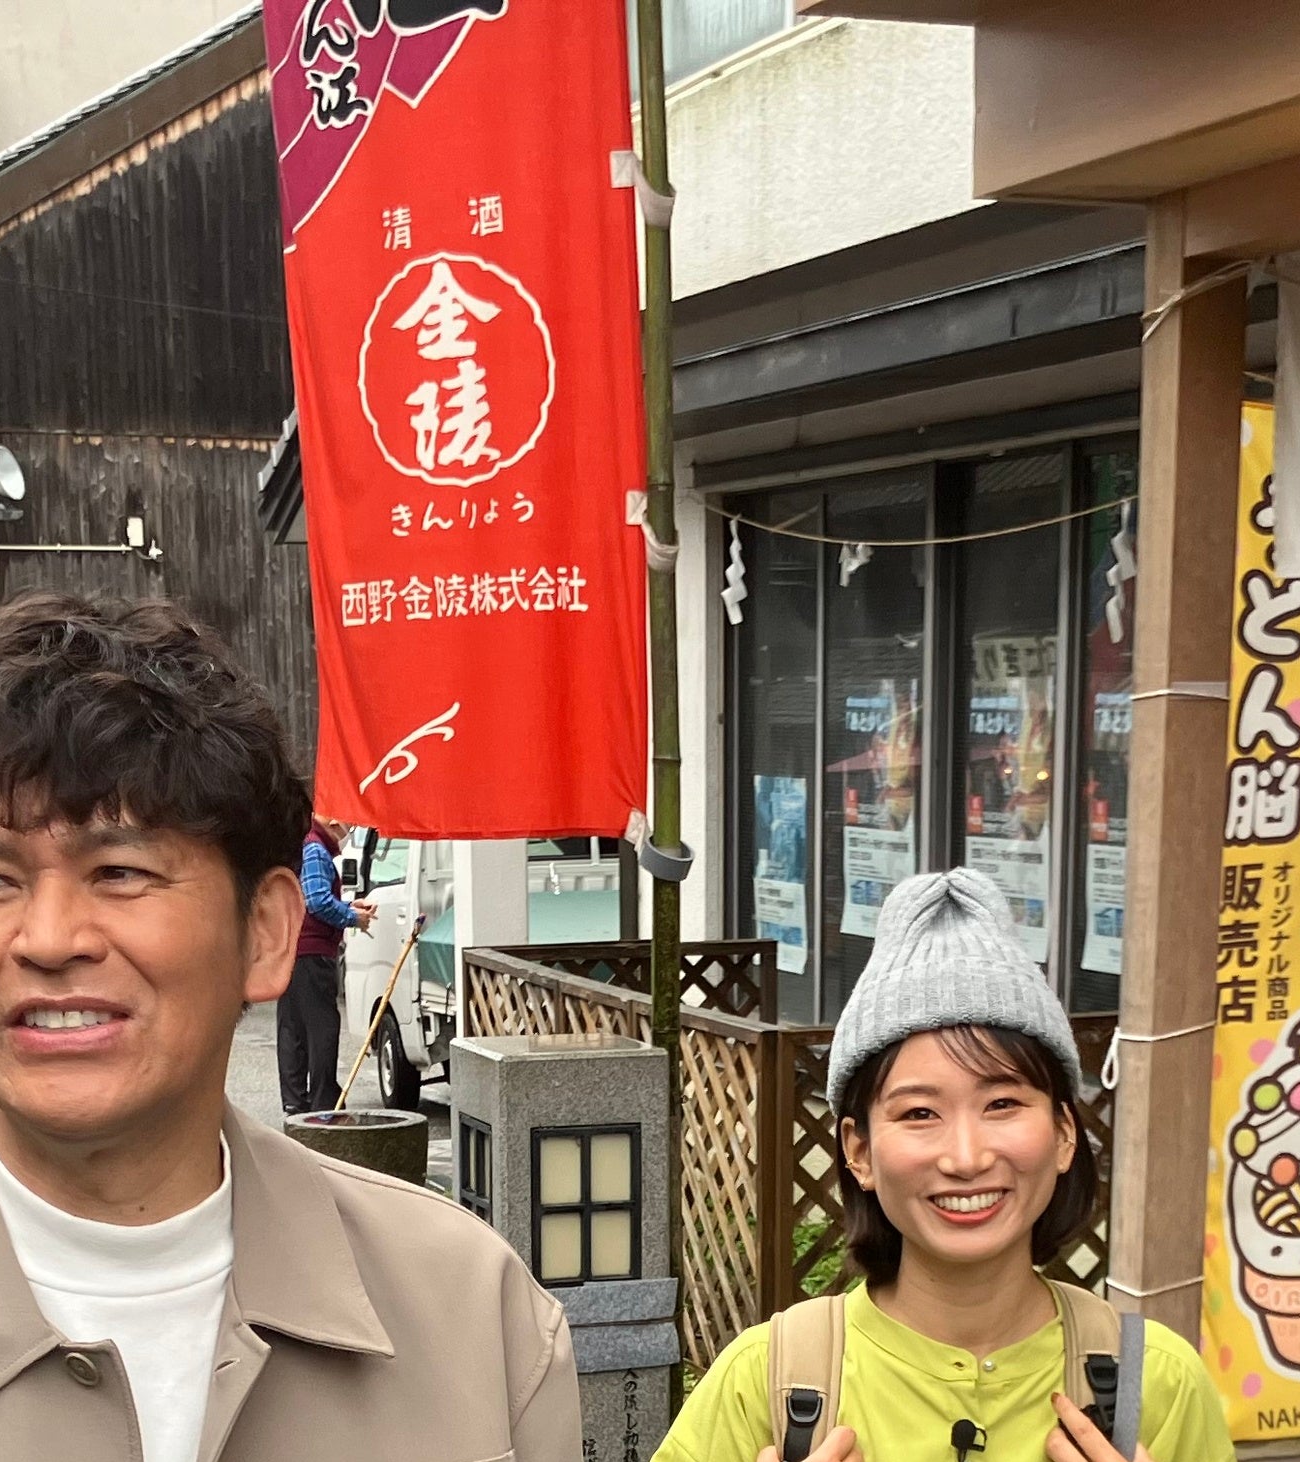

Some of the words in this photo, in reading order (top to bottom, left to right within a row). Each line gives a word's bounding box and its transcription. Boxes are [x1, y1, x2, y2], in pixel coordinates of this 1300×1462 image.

[382, 195, 505, 251] 清酒
[390, 261, 503, 471] 金陵
[390, 491, 535, 537] きんりょう
[341, 566, 589, 628] 西野金陵株式会社
[1216, 862, 1264, 1025] 販売店
[1265, 858, 1294, 1022] オリジナル商品
